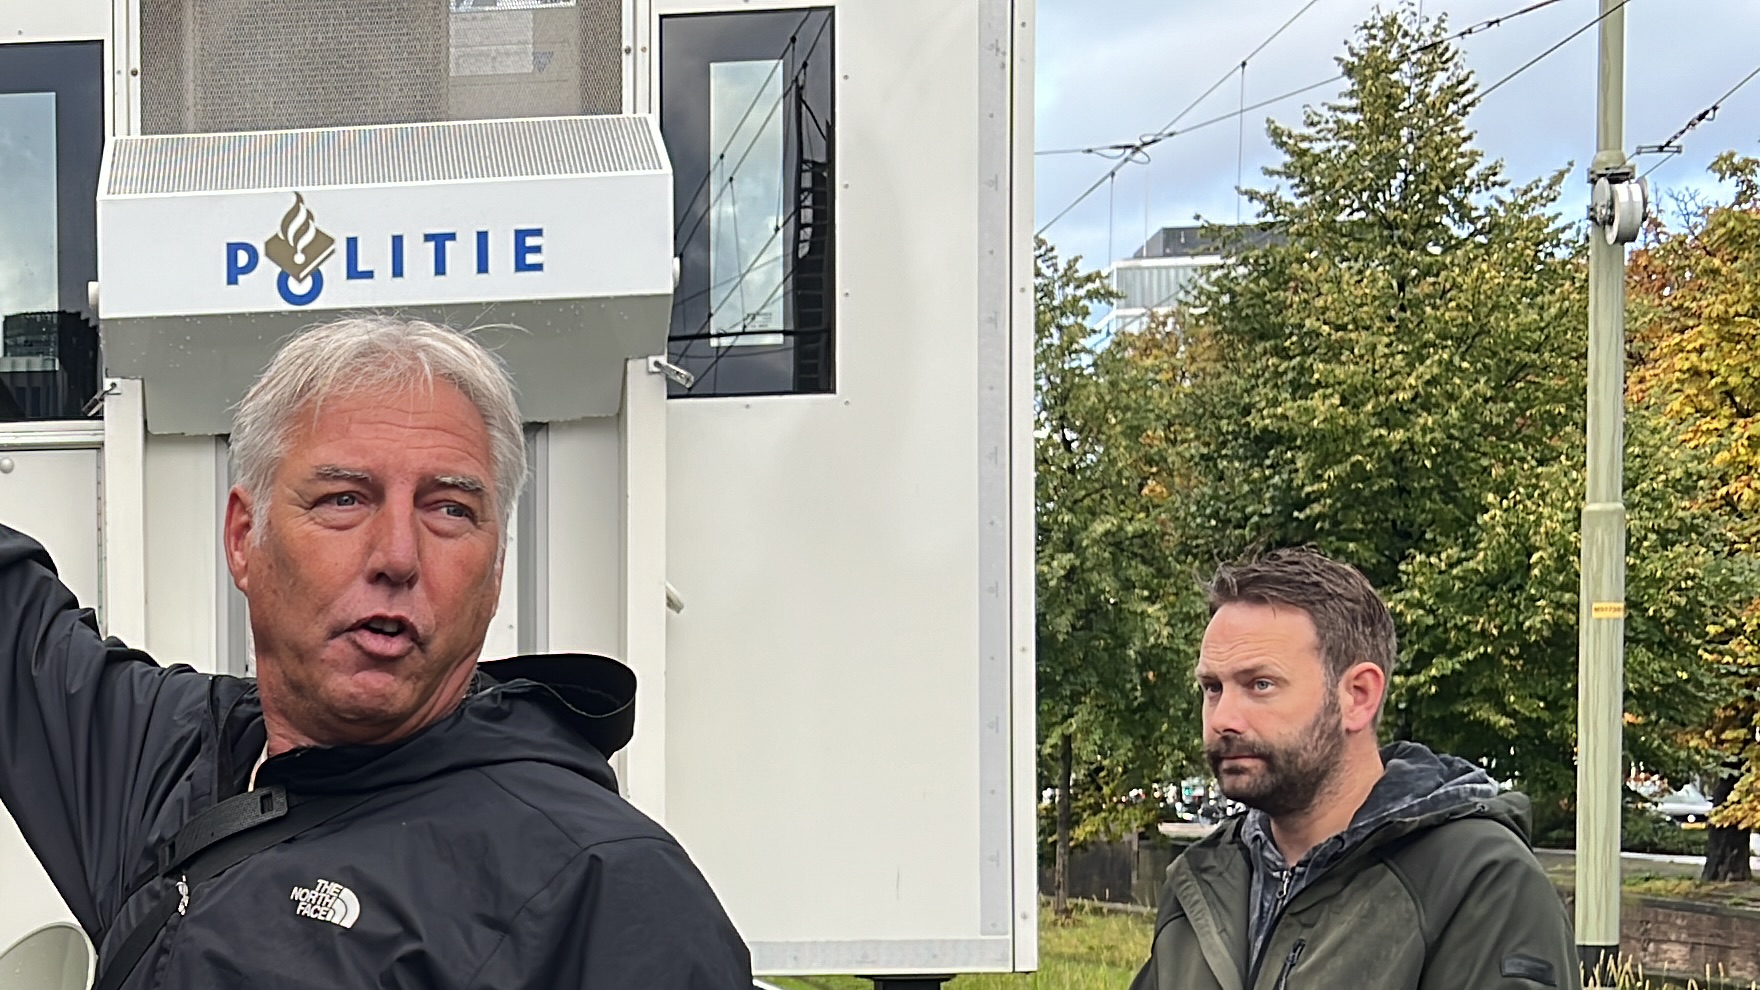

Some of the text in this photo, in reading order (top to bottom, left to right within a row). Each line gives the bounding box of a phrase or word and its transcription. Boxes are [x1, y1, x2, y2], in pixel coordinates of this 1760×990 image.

[225, 227, 544, 306] POLITIE
[290, 886, 337, 908] NORTH
[316, 879, 343, 896] THE
[296, 901, 330, 921] FACE
